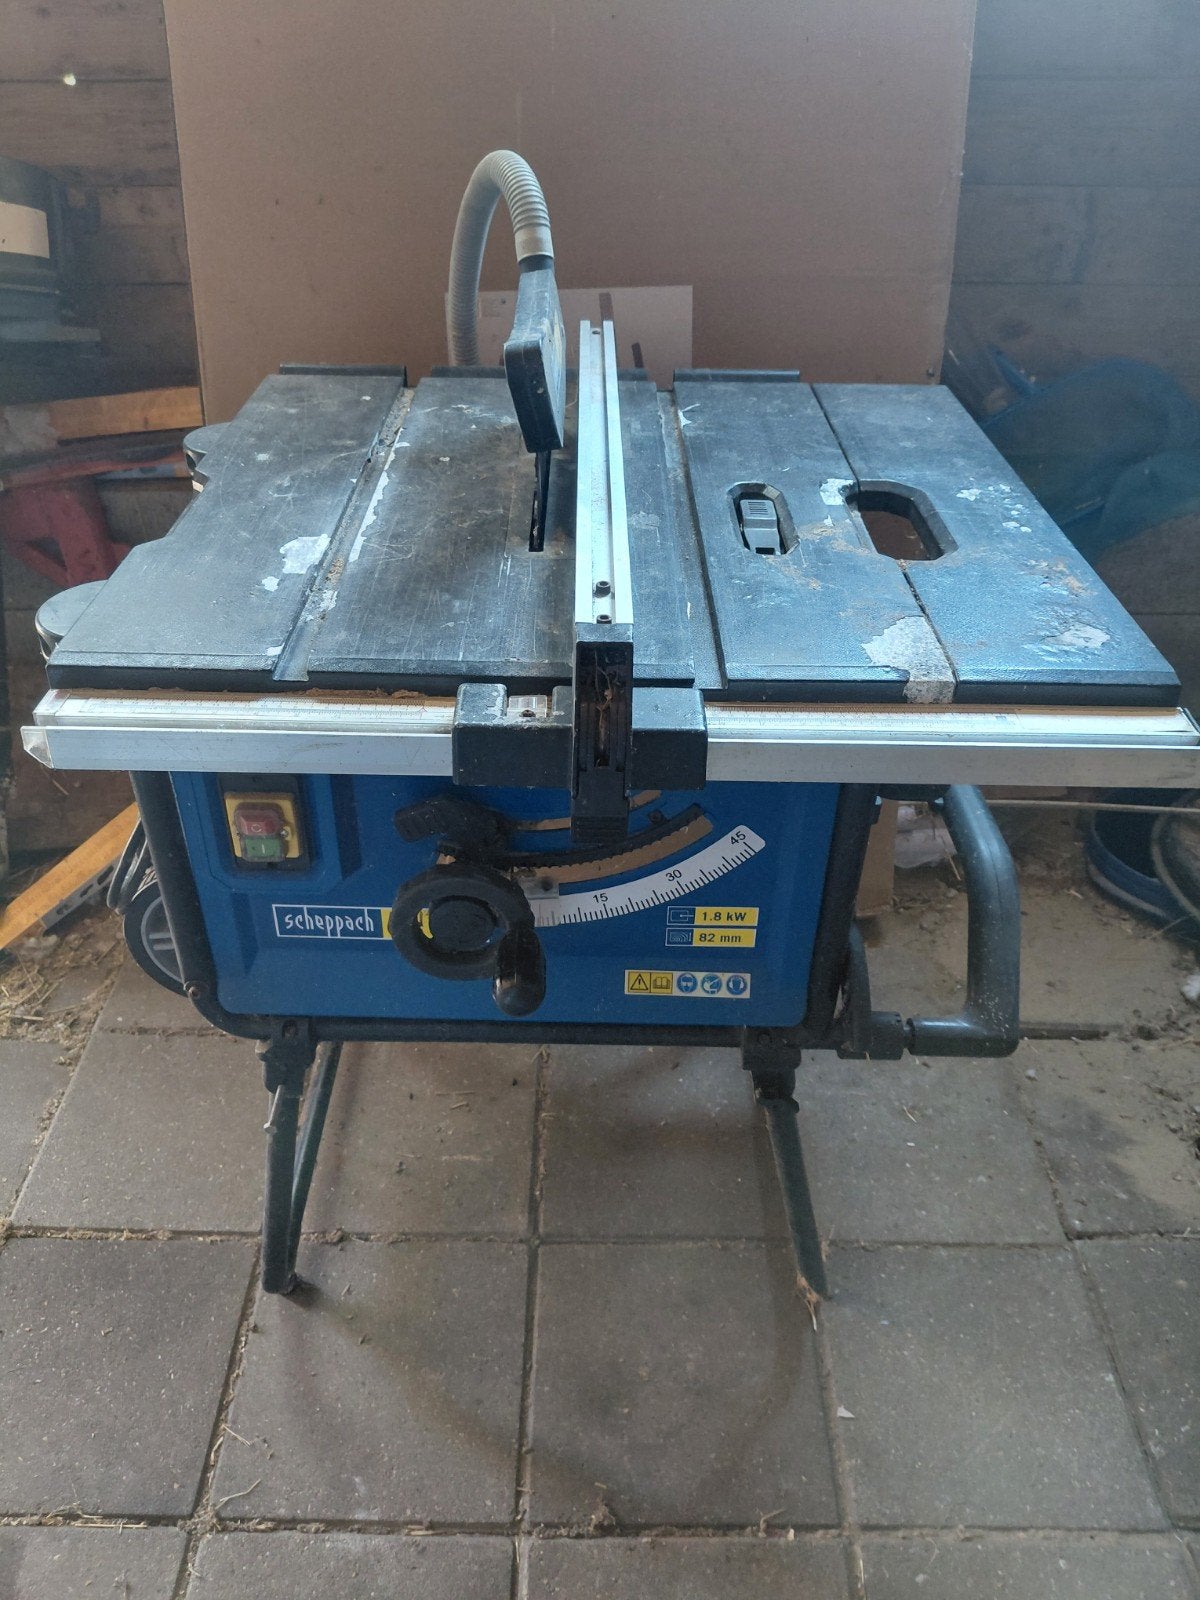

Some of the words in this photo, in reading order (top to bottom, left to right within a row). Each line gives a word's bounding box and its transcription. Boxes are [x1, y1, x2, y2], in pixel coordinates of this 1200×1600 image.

[730, 831, 746, 846] 45
[665, 869, 683, 882] 30
[592, 892, 609, 903] 15
[284, 906, 375, 937] scheppach
[702, 911, 722, 922] 1.8
[726, 912, 747, 922] kW
[699, 933, 716, 943] 82
[720, 934, 742, 943] mm
